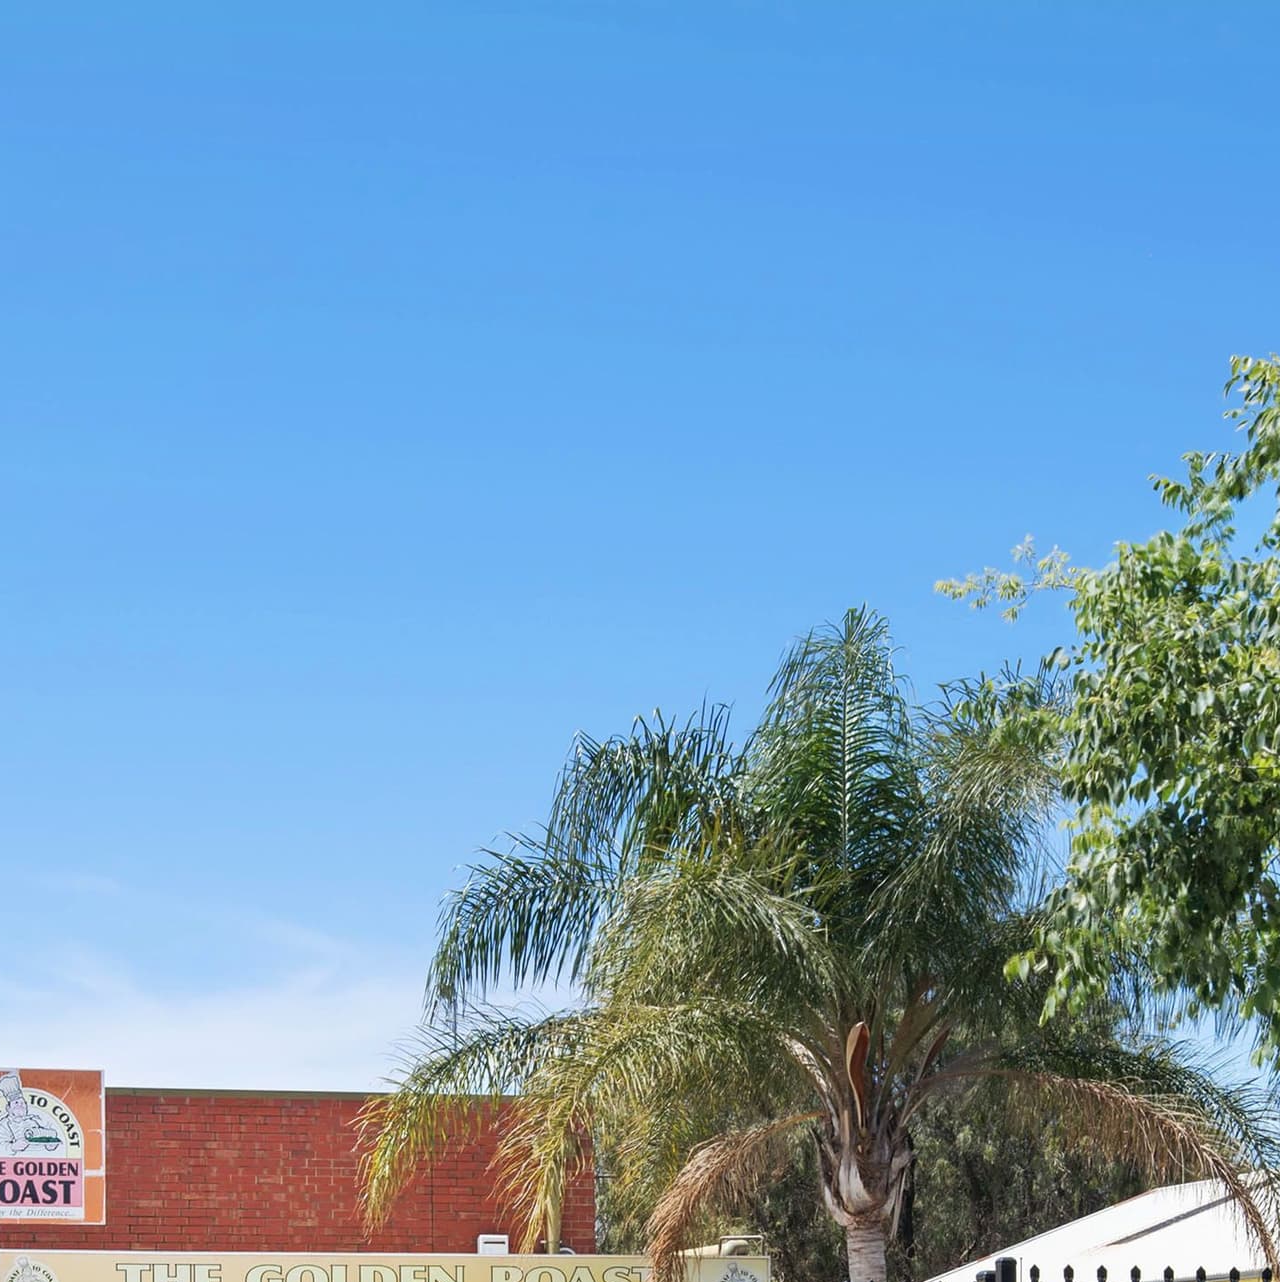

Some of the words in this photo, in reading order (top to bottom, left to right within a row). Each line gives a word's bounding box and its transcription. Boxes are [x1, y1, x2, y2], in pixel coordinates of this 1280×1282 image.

[29, 1094, 48, 1108] TO
[52, 1105, 80, 1148] COAST
[13, 1161, 79, 1176] GOLDEN
